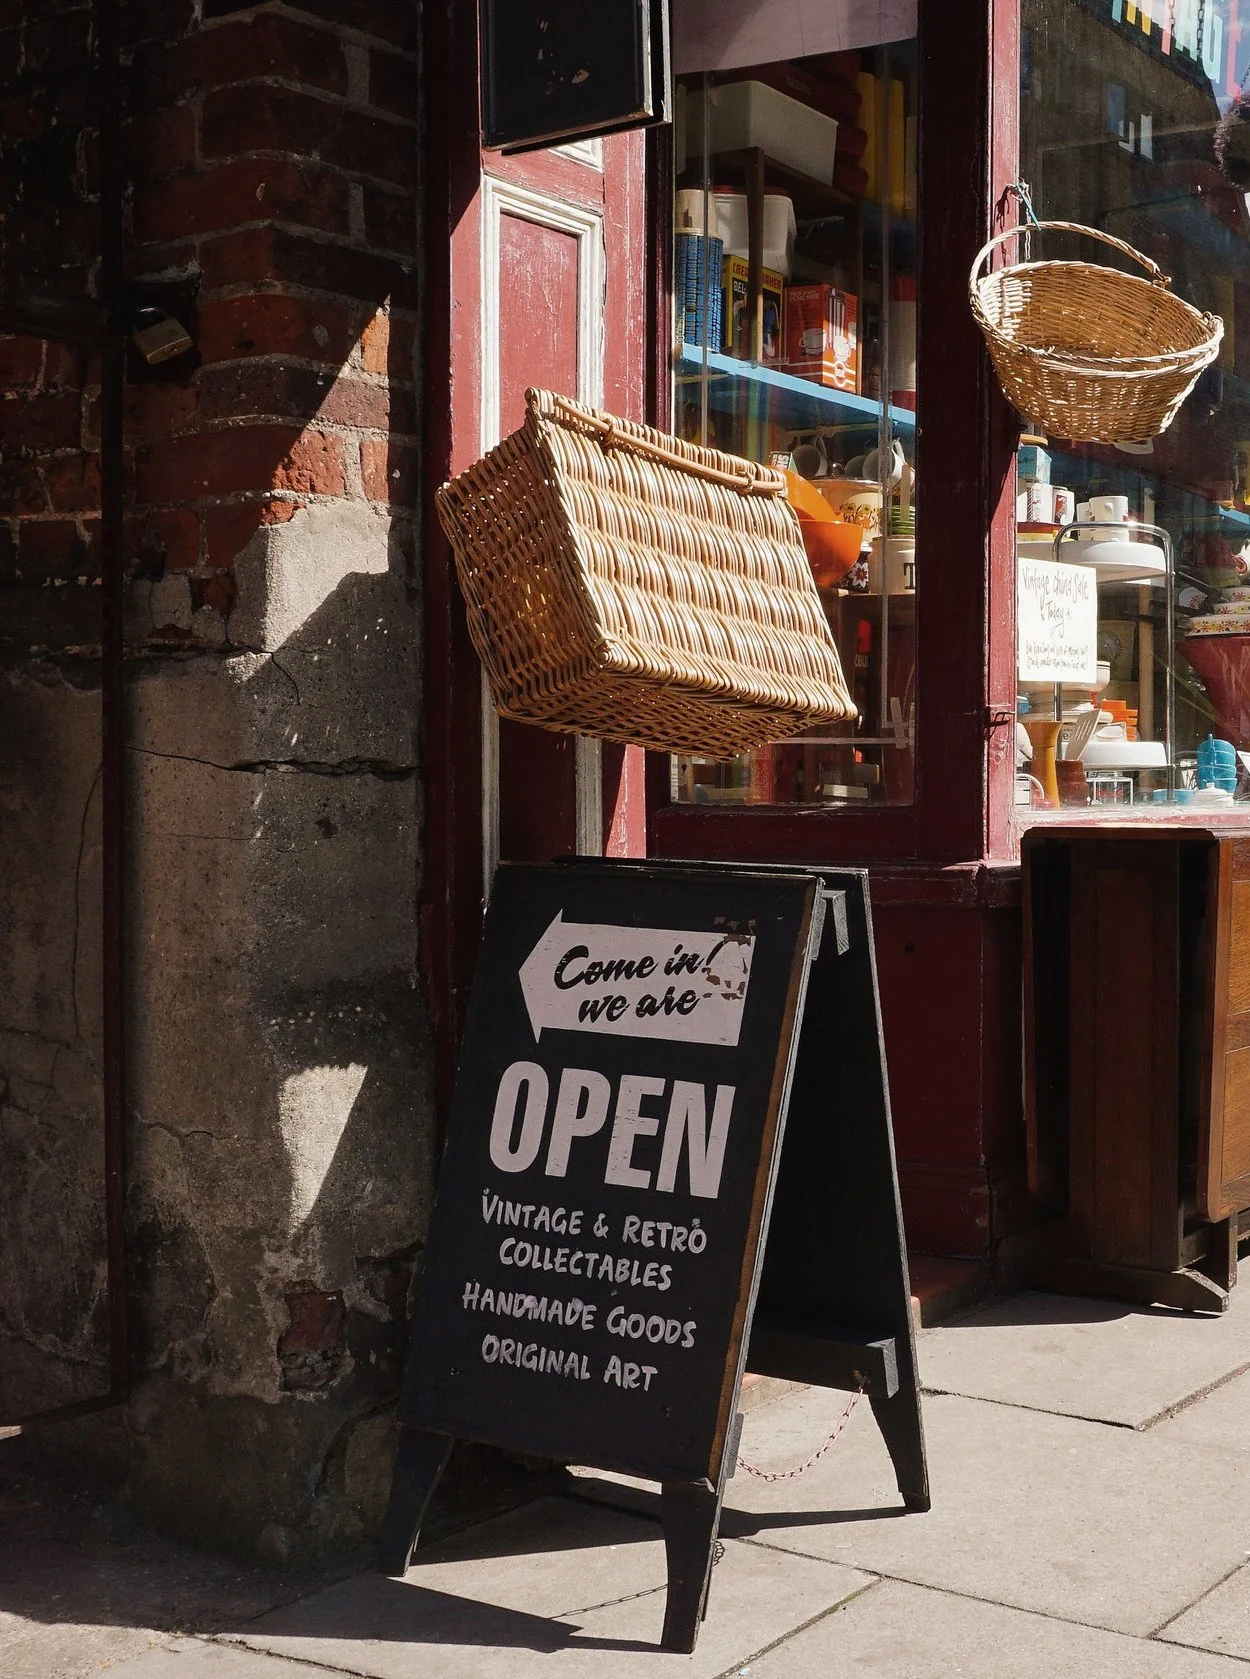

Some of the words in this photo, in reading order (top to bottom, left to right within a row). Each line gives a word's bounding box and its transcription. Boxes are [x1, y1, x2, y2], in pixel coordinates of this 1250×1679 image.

[553, 944, 659, 989] Come
[578, 995, 630, 1022] we
[636, 990, 700, 1018] are
[489, 1061, 736, 1199] OPEN
[482, 1188, 584, 1236] VINTAGE
[593, 1215, 609, 1238] &
[499, 1239, 672, 1291] COLLECTABLES
[462, 1281, 594, 1332] HANDMADE
[606, 1306, 697, 1348] GOODS
[481, 1334, 590, 1382] ORIGINAL
[604, 1354, 658, 1393] ART
